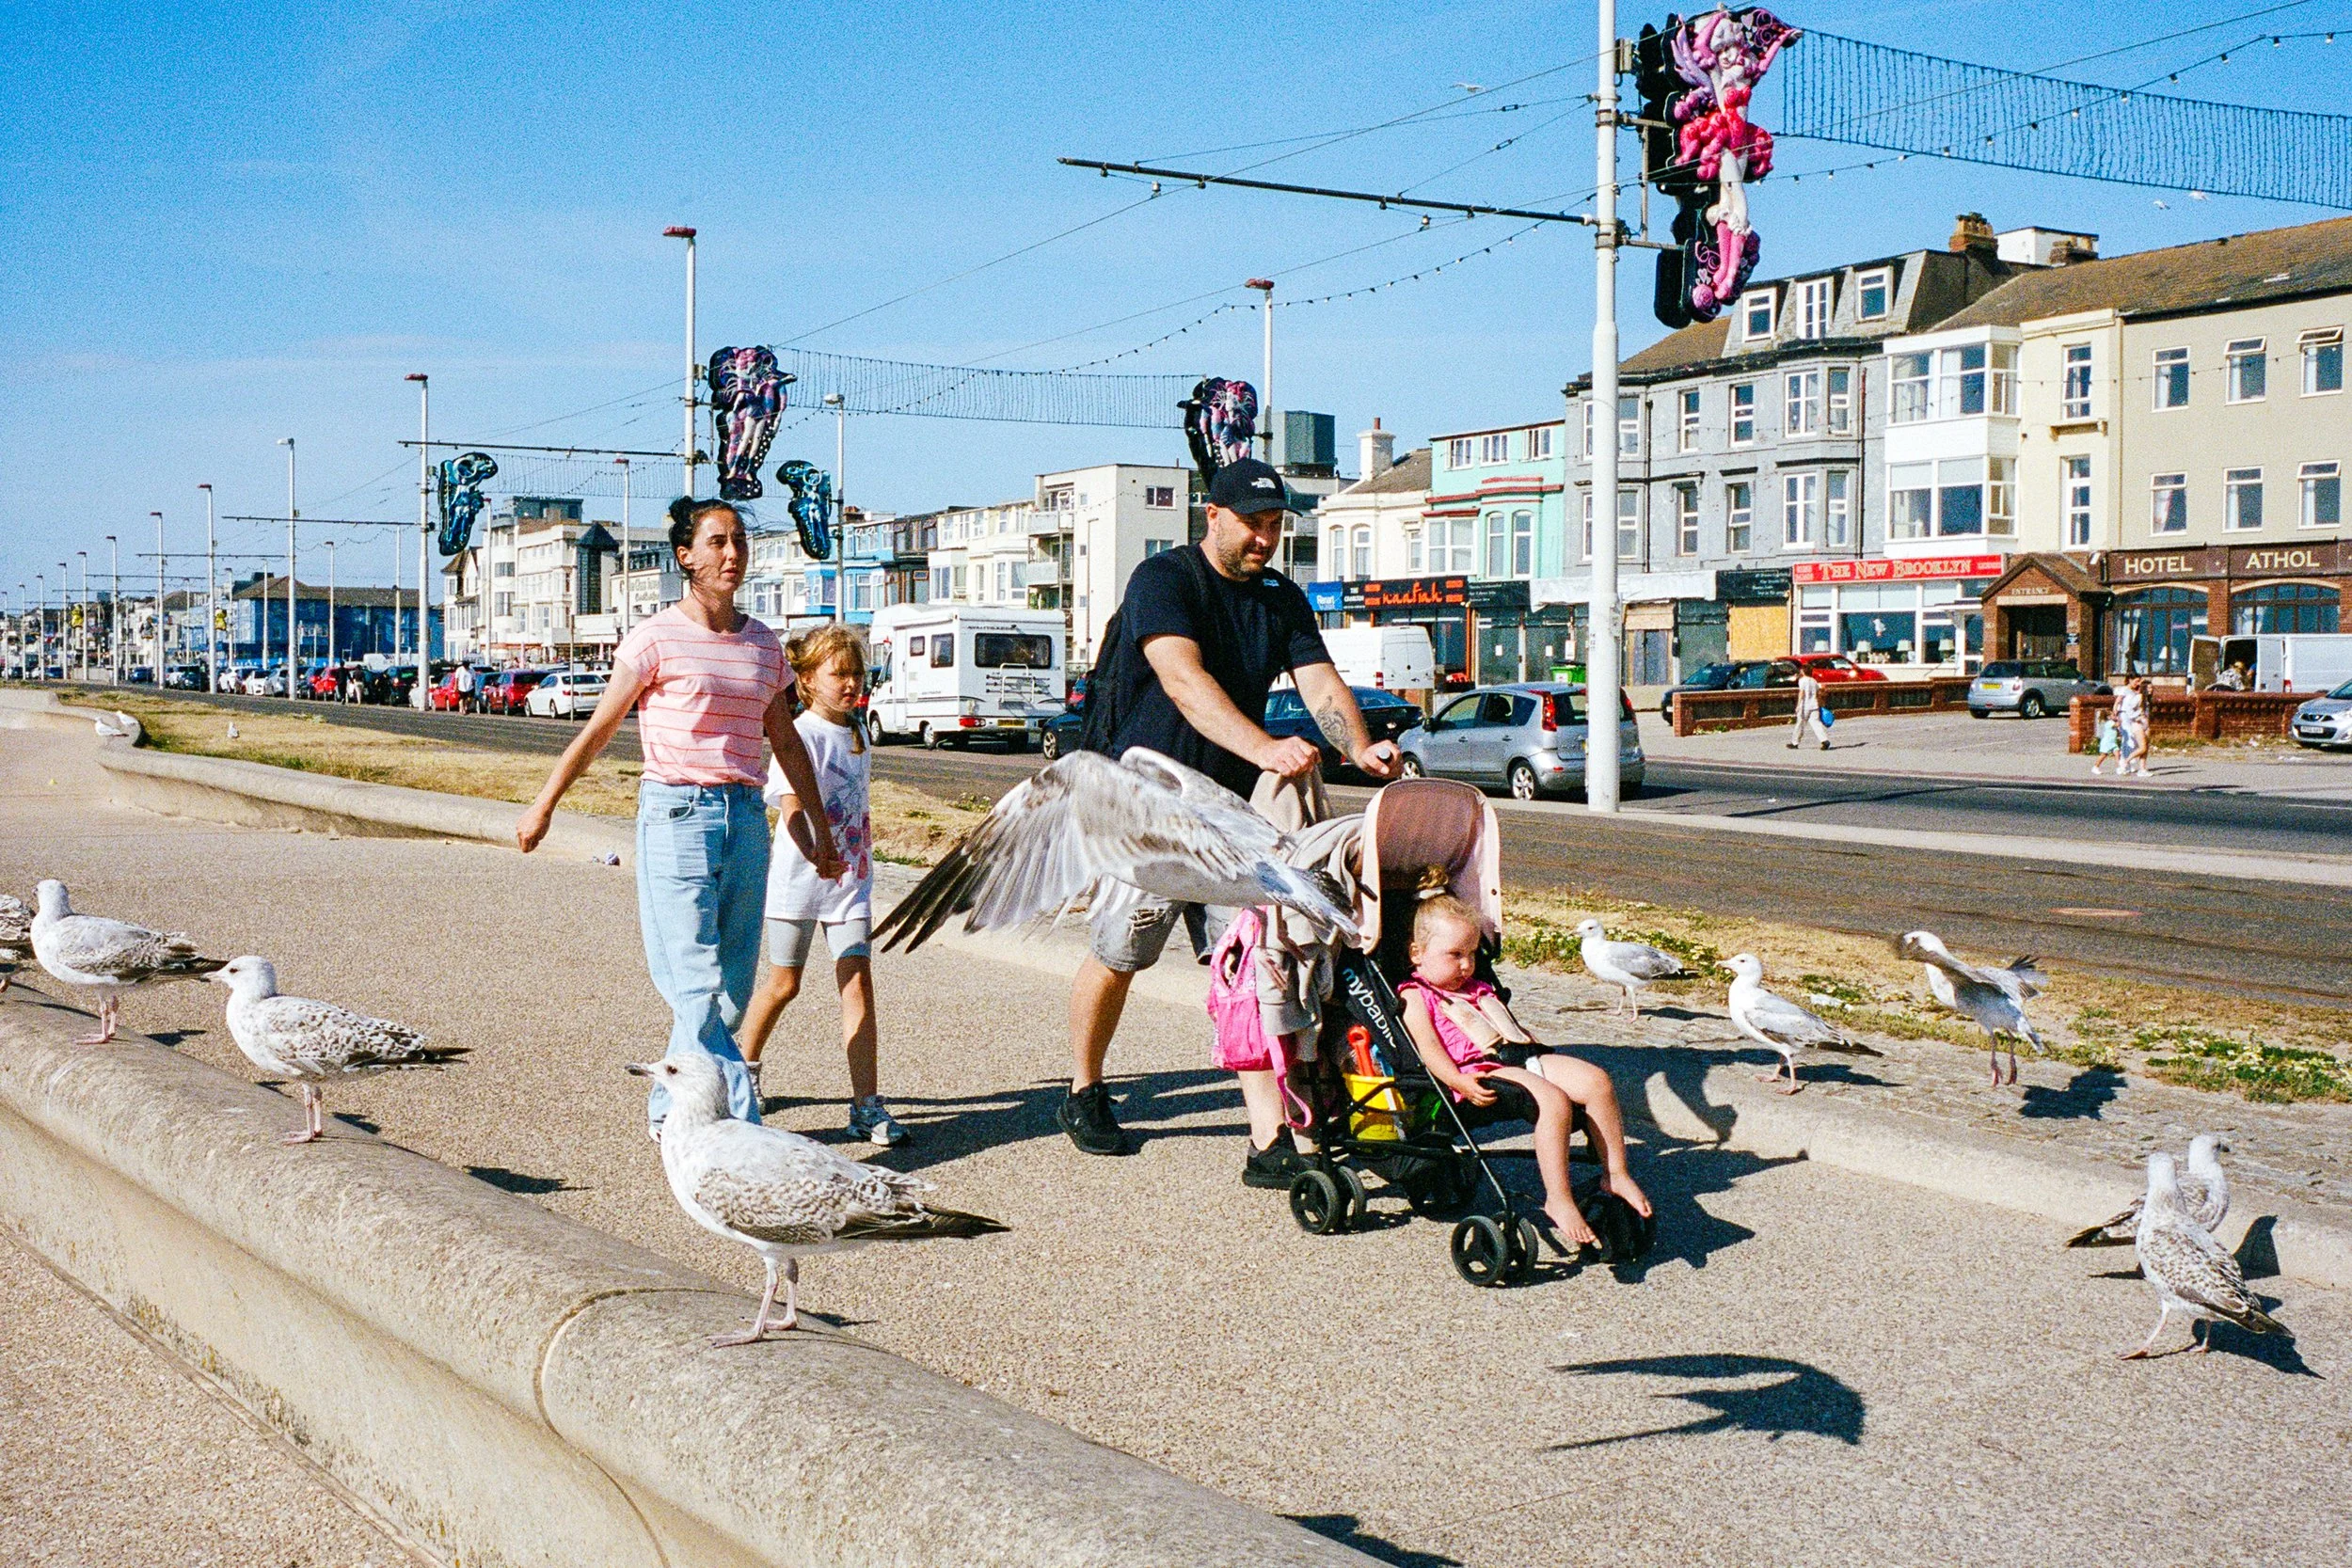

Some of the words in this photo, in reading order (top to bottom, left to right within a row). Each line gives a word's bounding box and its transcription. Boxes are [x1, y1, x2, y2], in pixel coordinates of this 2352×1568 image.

[1818, 562, 1851, 580] THE
[1854, 561, 1889, 579] NEW
[1893, 559, 1972, 578] BROOKLYN
[2123, 555, 2193, 575] HOTEL
[2245, 550, 2320, 570] ATHOL
